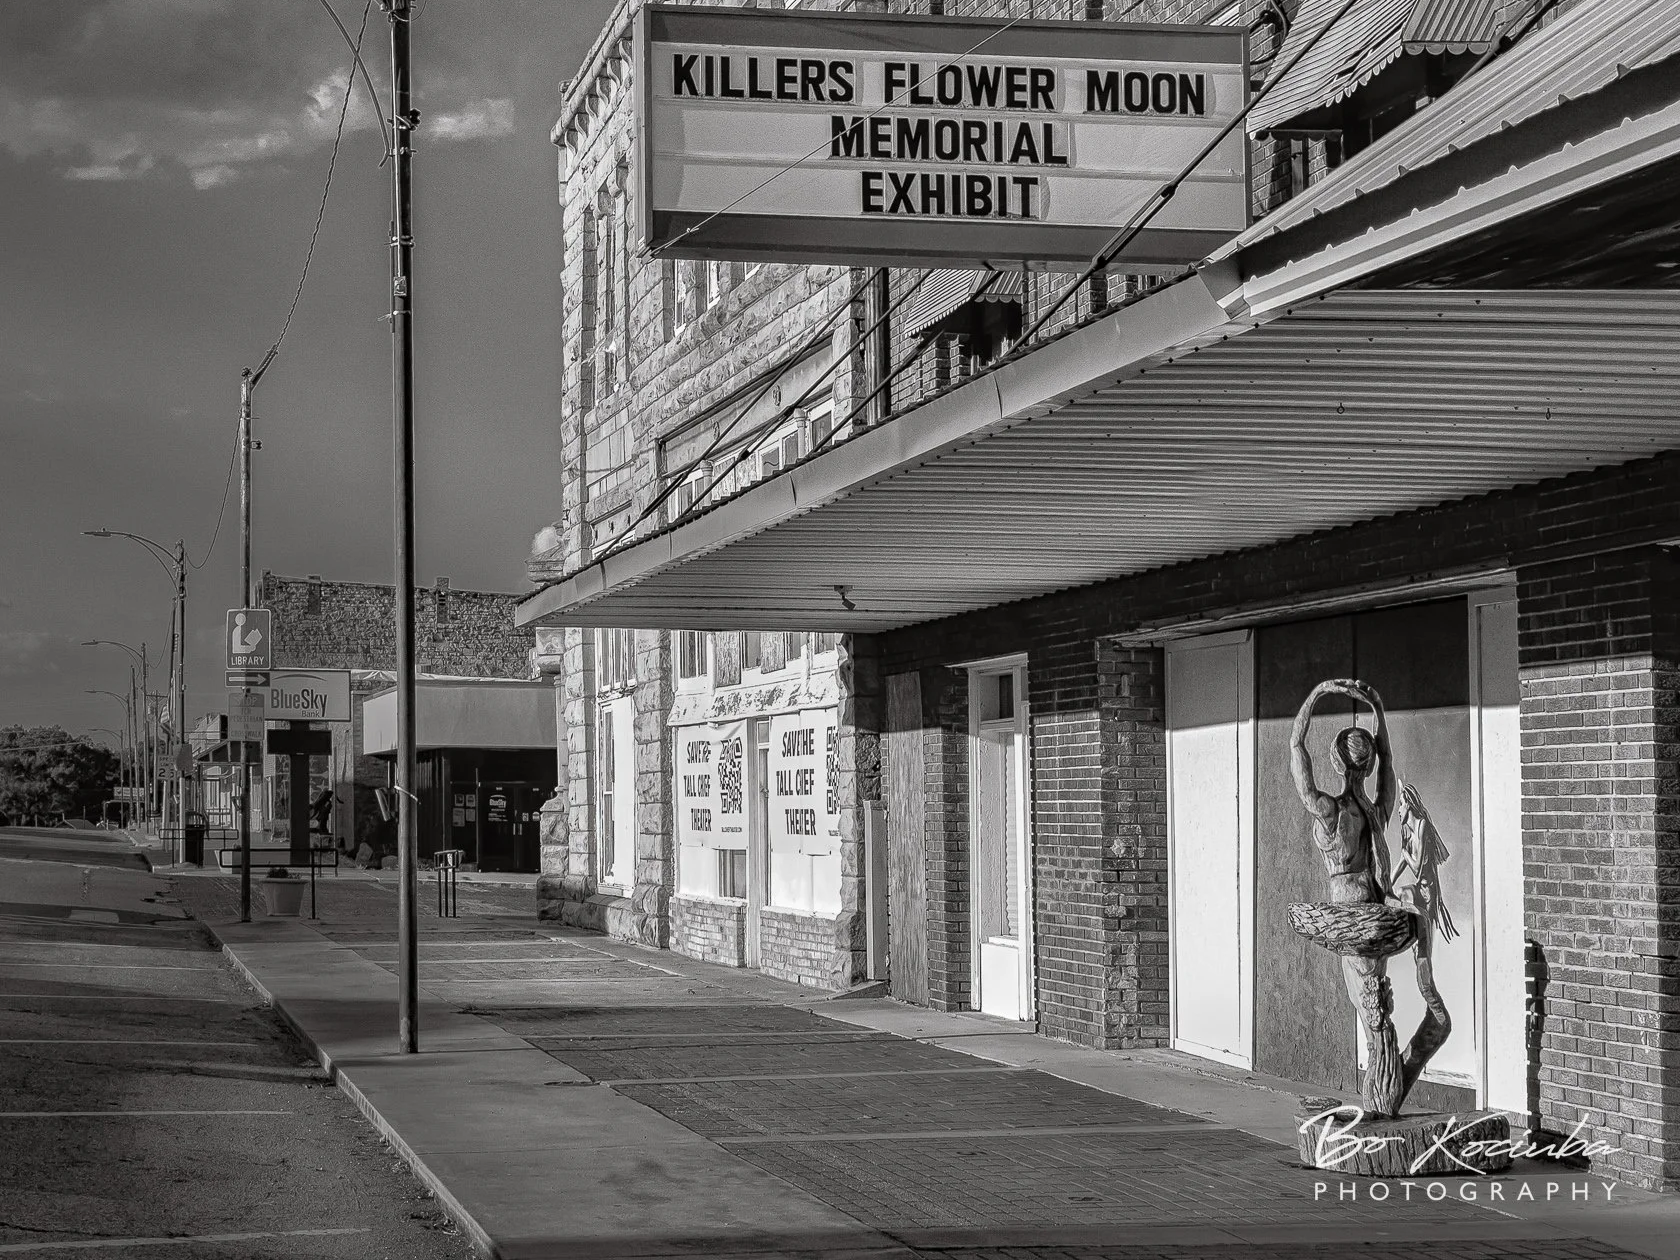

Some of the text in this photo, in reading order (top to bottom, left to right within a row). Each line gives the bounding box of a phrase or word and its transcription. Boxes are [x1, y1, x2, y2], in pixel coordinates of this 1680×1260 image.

[673, 53, 1205, 115] KILLERS FLOWER MOON
[830, 115, 1068, 165] MEMORIAL
[861, 171, 1038, 219] EXHIBIT
[231, 656, 264, 666] LIBRARY
[271, 689, 328, 718] BlueSky
[301, 710, 320, 718] Bank
[776, 769, 794, 796] TALL
